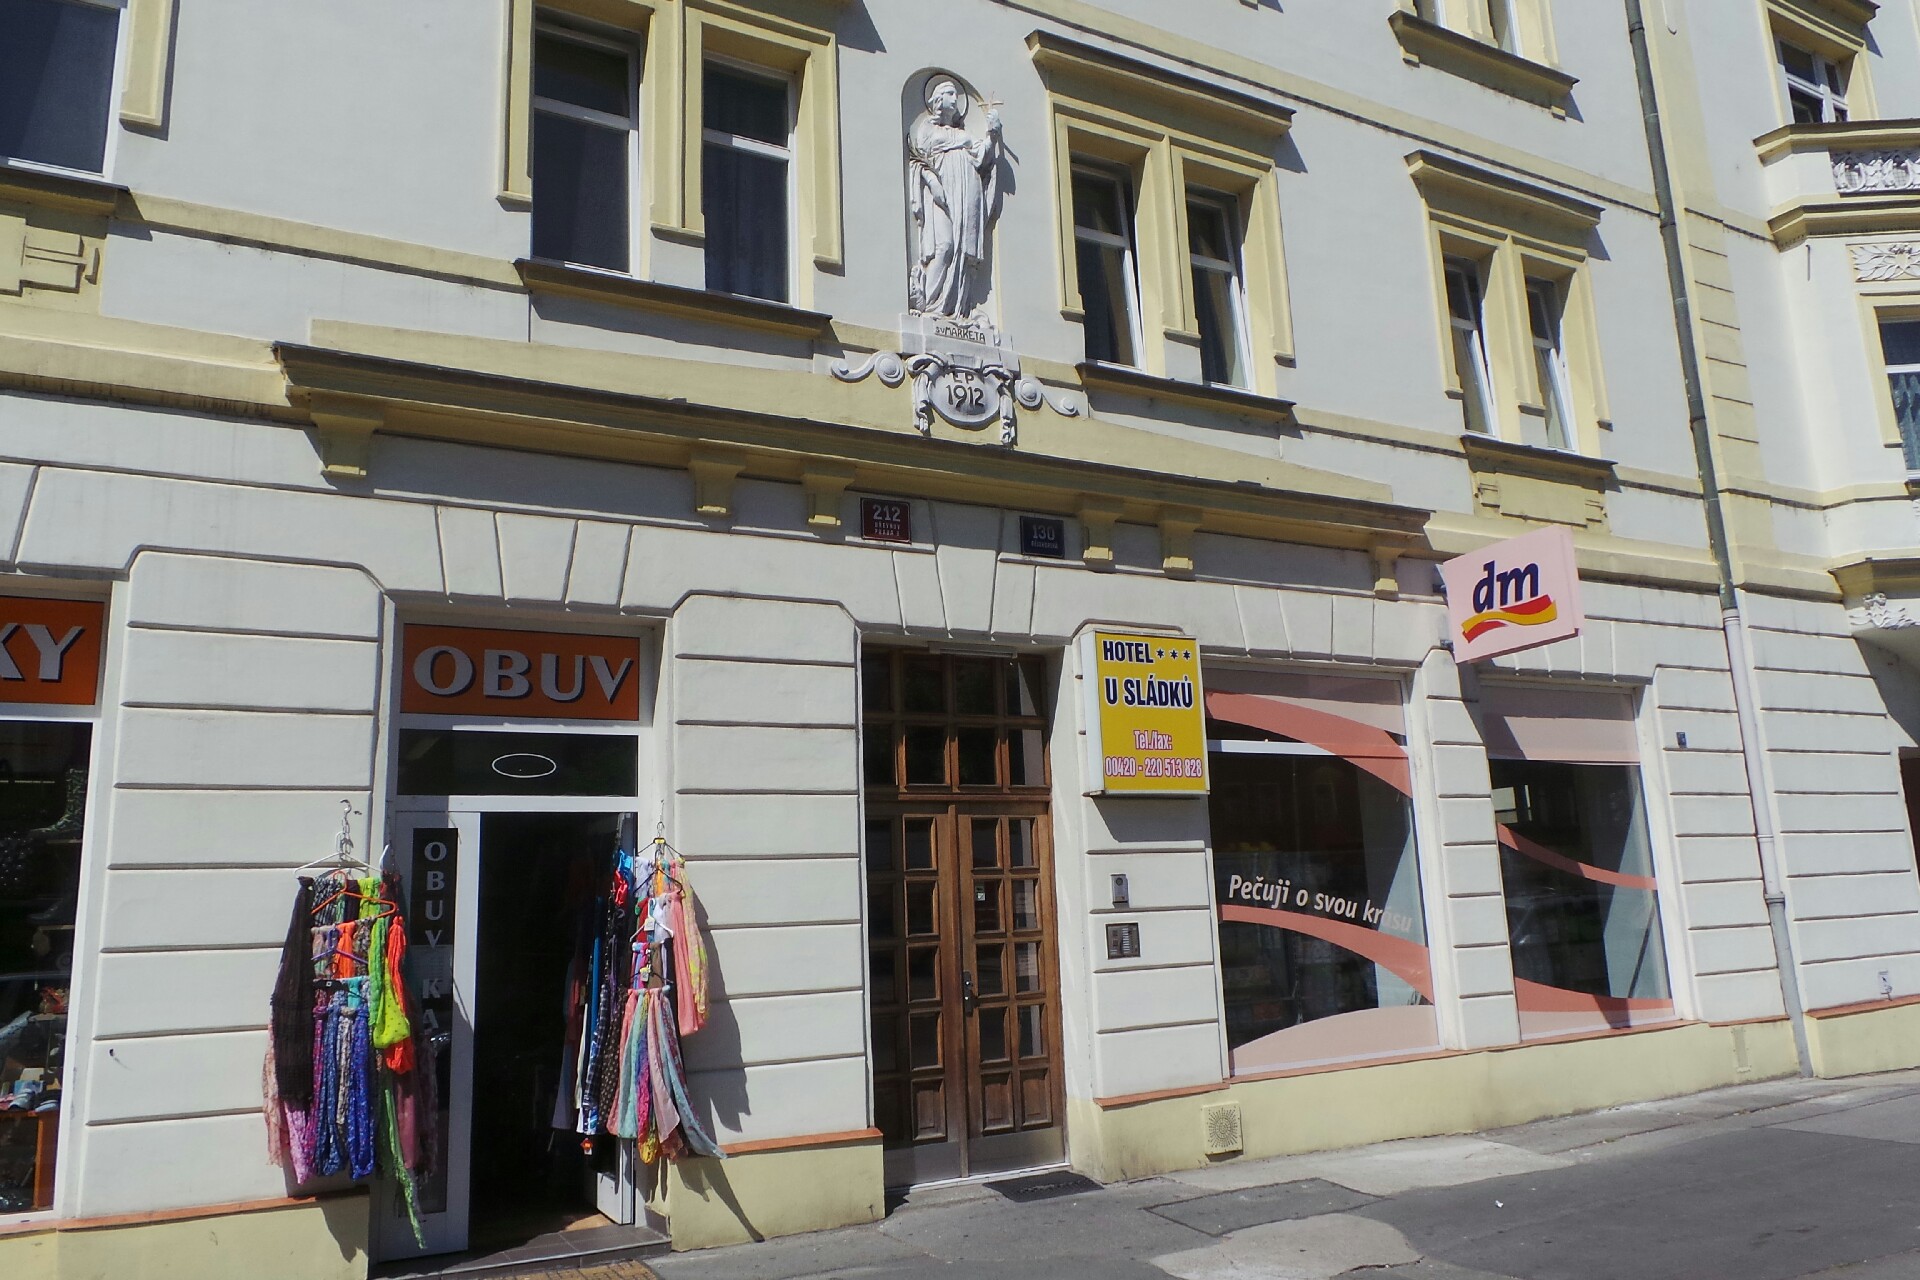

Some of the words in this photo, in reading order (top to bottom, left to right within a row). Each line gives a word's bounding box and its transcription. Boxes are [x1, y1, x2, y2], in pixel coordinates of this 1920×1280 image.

[945, 384, 985, 409] 1912
[872, 504, 901, 522] 212
[1032, 524, 1056, 541] 130
[1472, 560, 1539, 614] dm
[1102, 640, 1154, 664] HOTEL
[413, 645, 634, 705] OBUV
[1104, 677, 1118, 705] U
[1123, 674, 1194, 709] SLÁDKŮ
[1105, 755, 1136, 777] 00420
[1144, 757, 1164, 778] 220
[1164, 757, 1183, 778] 513
[1184, 758, 1204, 778] 828
[423, 841, 448, 949] OBUV
[1228, 874, 1292, 910] Pečuji
[1295, 889, 1309, 907] o
[1313, 892, 1359, 919] svou
[1362, 899, 1414, 932] krásu
